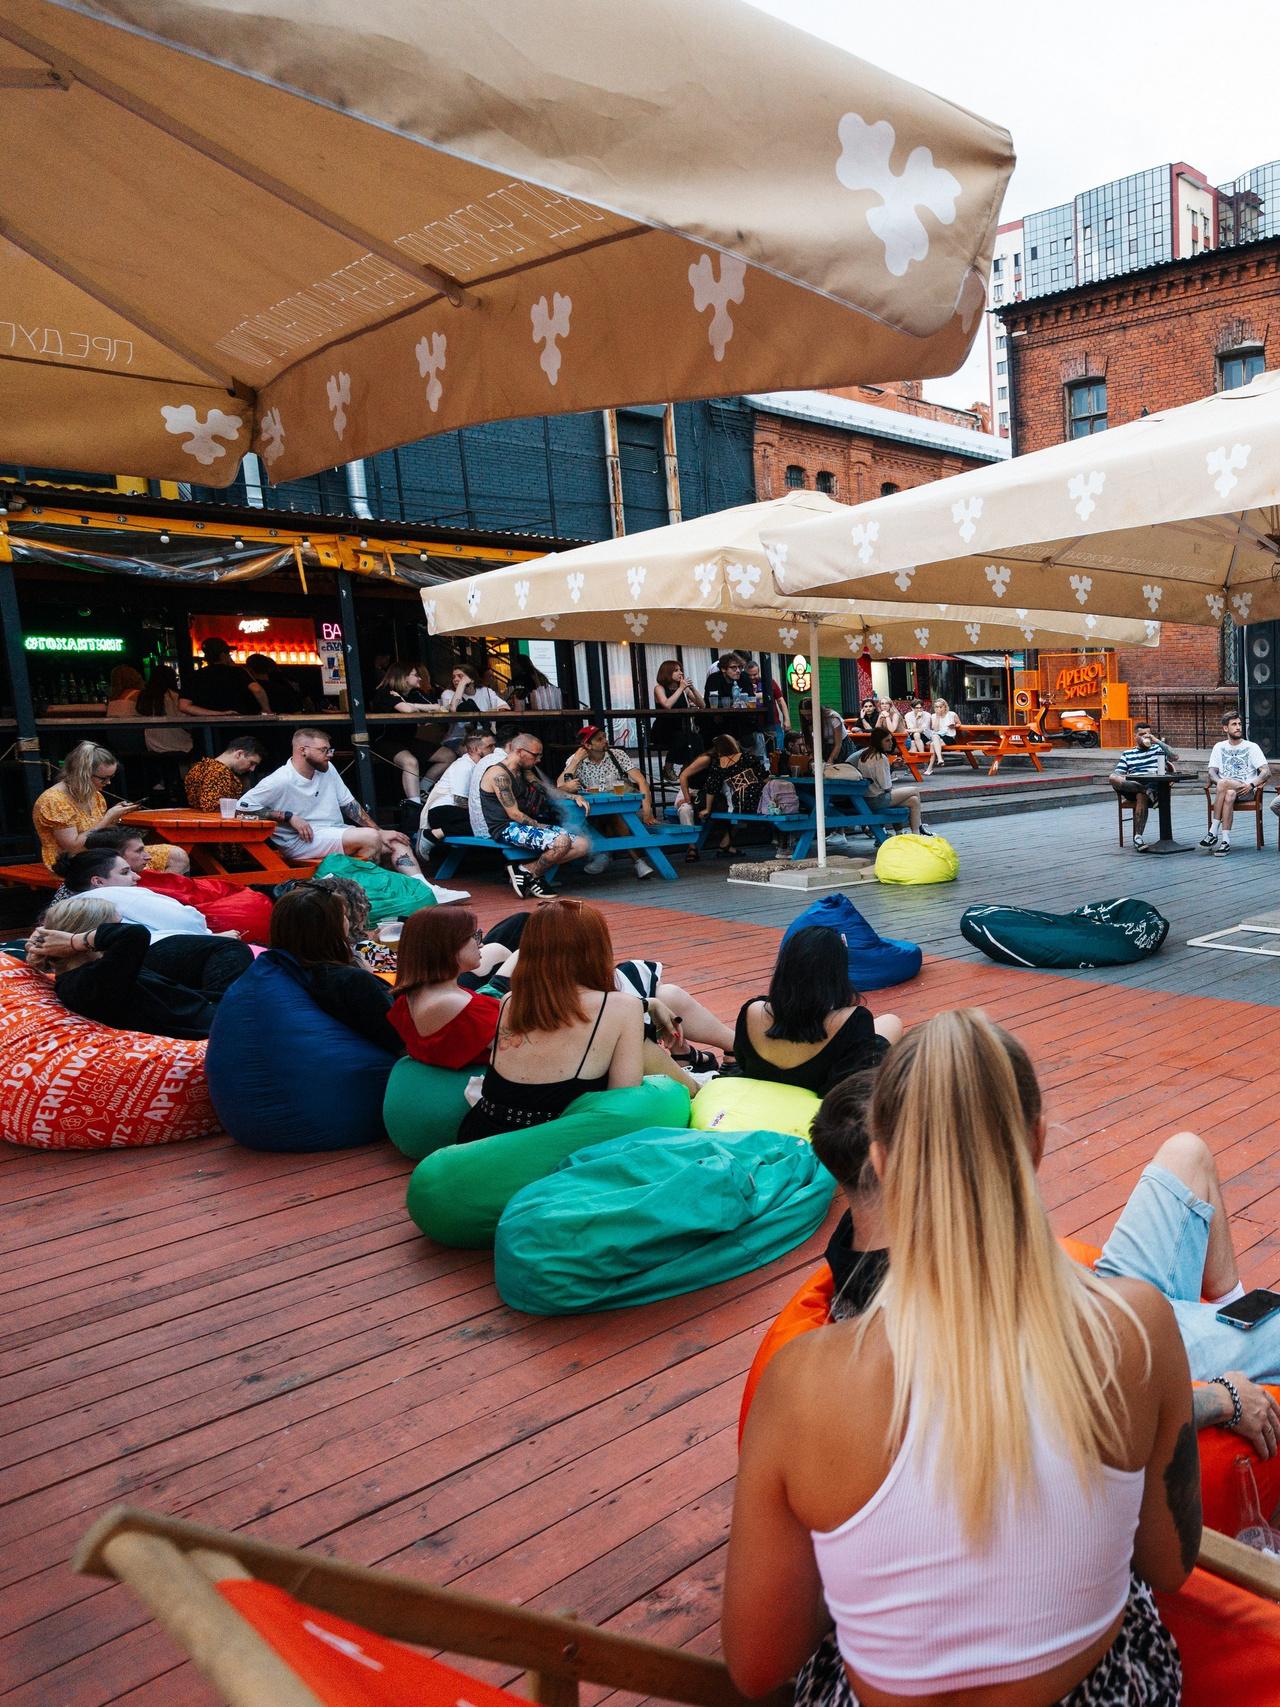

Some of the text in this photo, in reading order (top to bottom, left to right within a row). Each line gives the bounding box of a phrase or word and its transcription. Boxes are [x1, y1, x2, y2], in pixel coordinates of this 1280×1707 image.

[1055, 661, 1106, 691] APEROL
[1064, 680, 1099, 700] SPRITZ
[31, 1046, 99, 1143] APERITIVO
[95, 1060, 129, 1108] ORIGINALE
[106, 1084, 130, 1112] PADOVA
[114, 1058, 156, 1123] Spontaneous
[141, 1064, 166, 1100] SELEZIONATE
